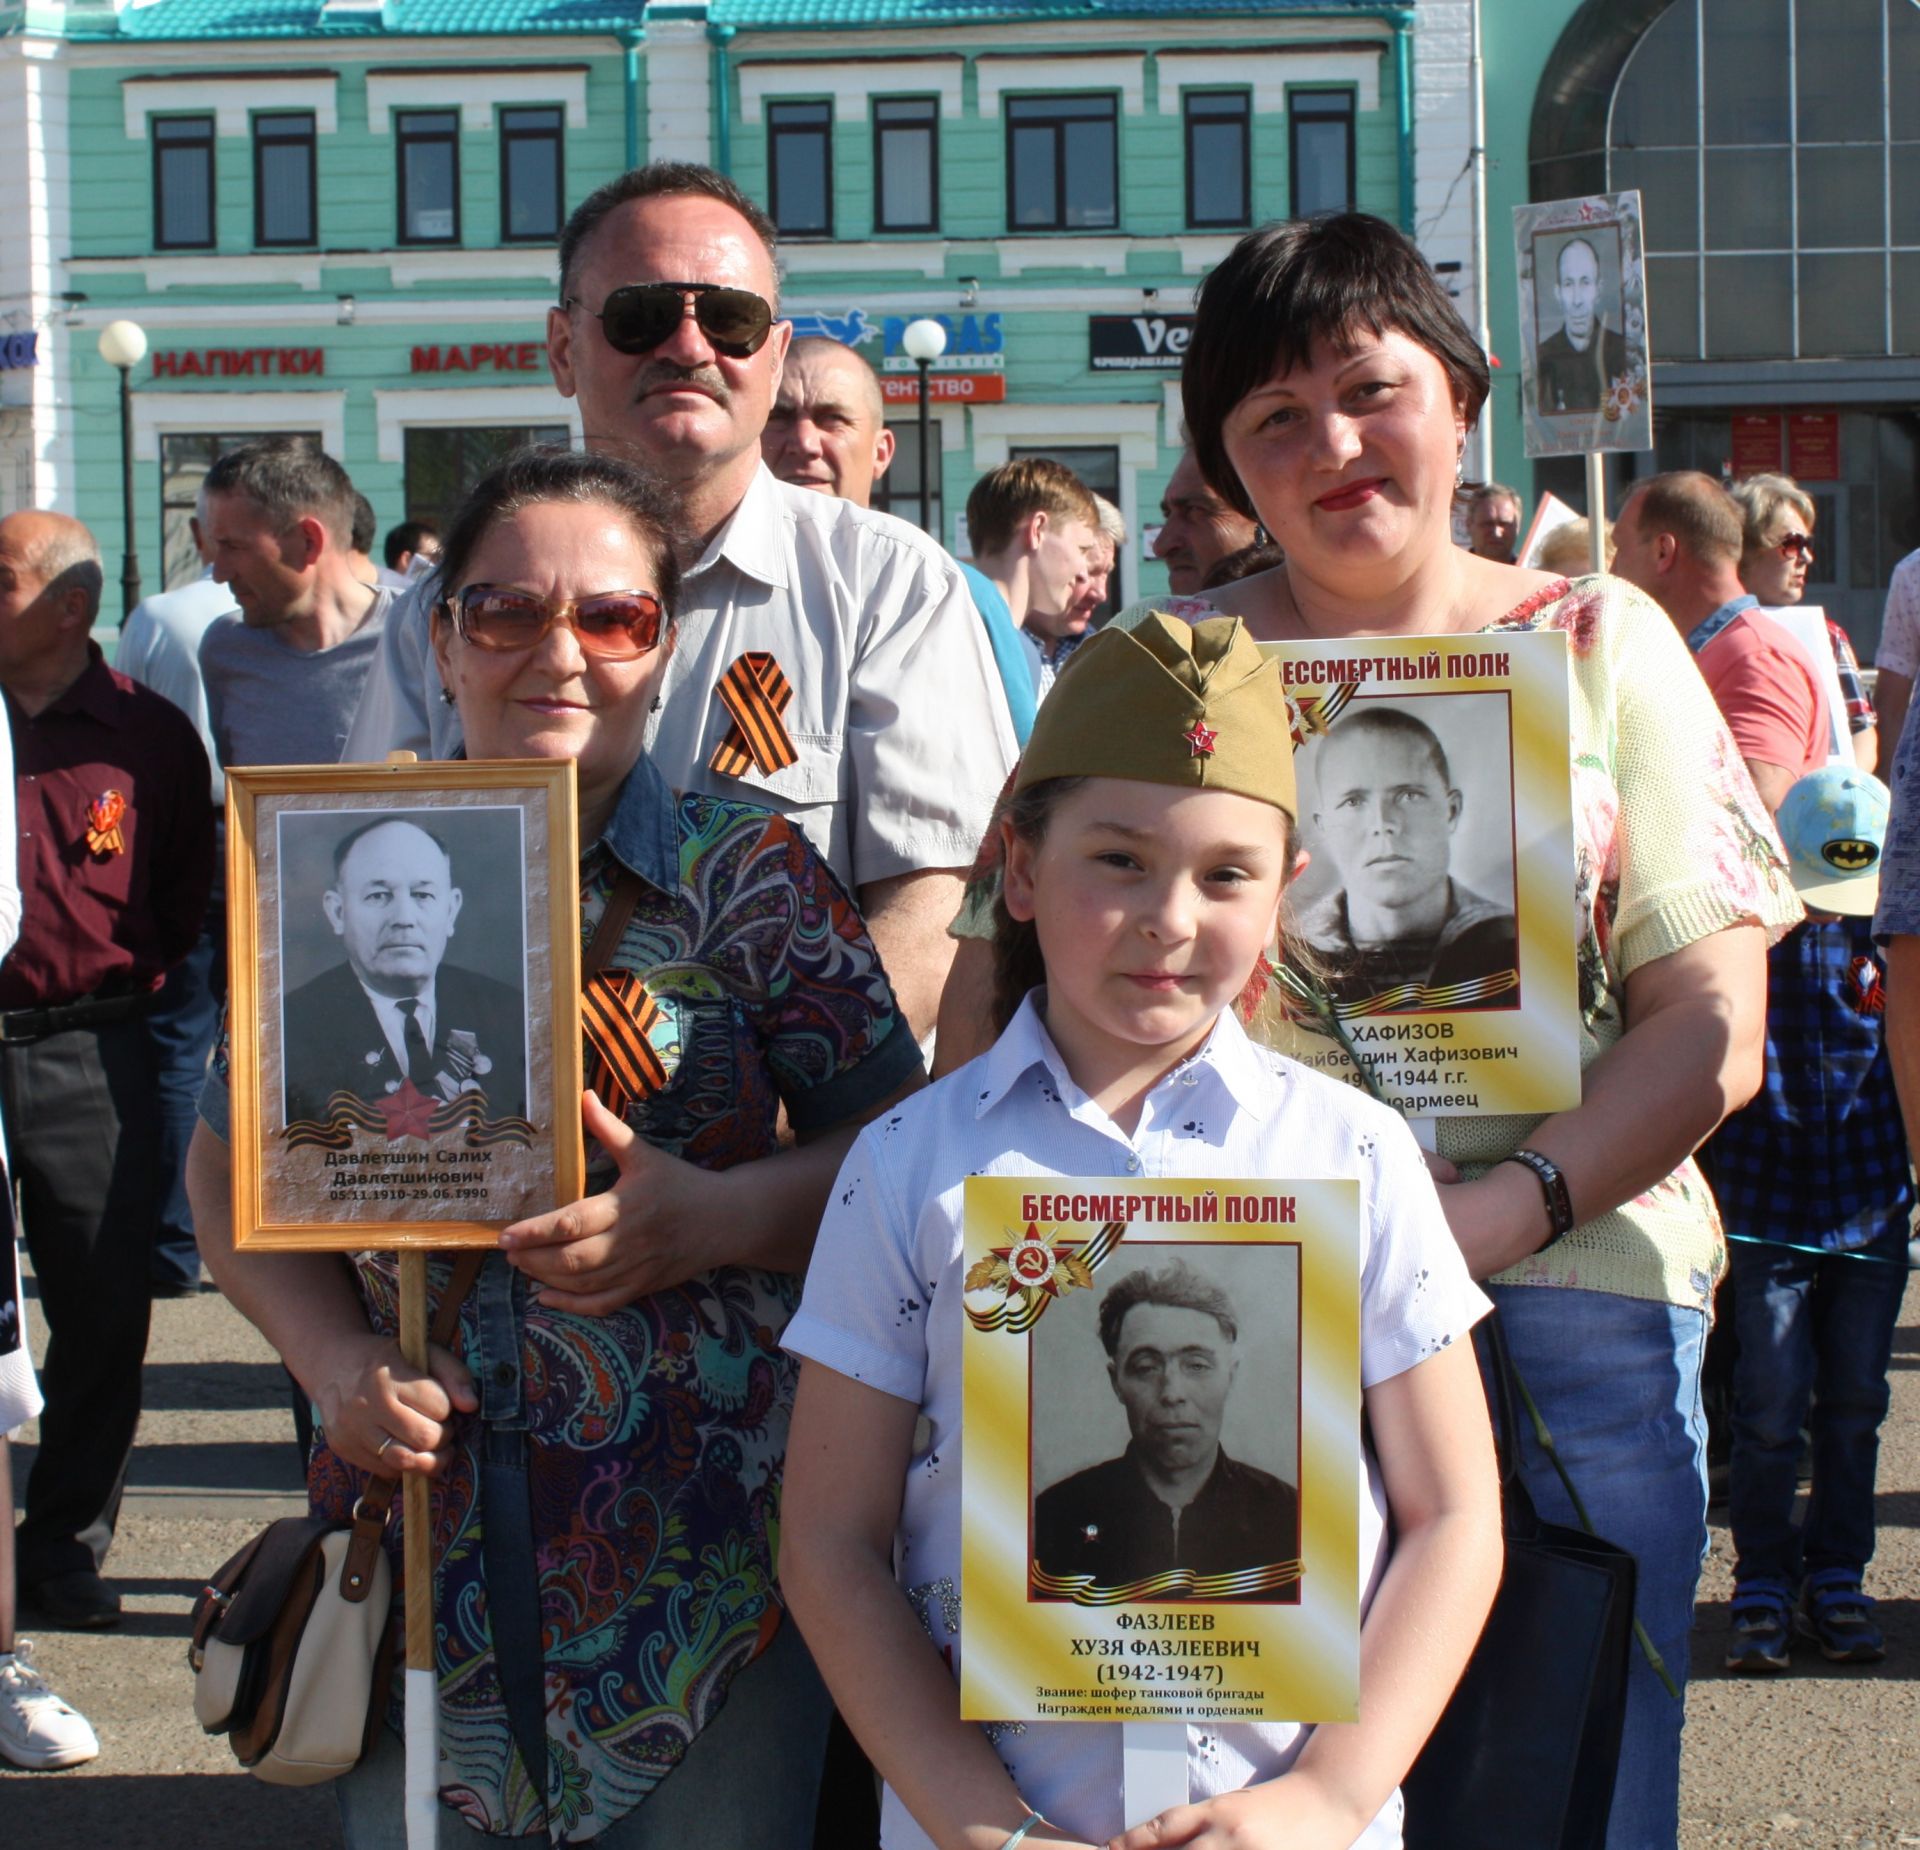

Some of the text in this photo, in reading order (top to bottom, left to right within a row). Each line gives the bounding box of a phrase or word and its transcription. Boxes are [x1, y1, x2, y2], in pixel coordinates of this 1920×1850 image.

[1132, 318, 1194, 354] Ve
[153, 348, 324, 378] НАПИТКИ
[1280, 651, 1511, 685] ЕССМЕРТНЫЙ ПОЛК
[1352, 1023, 1454, 1042] ХАФИЗОВ
[1288, 1046, 1518, 1067] Хайбедин Хафизович
[1342, 1070, 1468, 1088] 191-1944 г.г.
[325, 1149, 492, 1167] Давлетшин Салих
[333, 1171, 484, 1187] Давлетшинович
[330, 1188, 488, 1201] 05.11.1910-29.06.1990
[1022, 1190, 1297, 1223] БЕССМЕРТНЫЙ ПОЛК
[1116, 1613, 1215, 1631] ФАЗЛЕЕВ
[1071, 1639, 1260, 1657] ХУЗЯ ФАЗЛЕЕВИЧ
[1097, 1664, 1224, 1685] (1942-1947)
[1036, 1686, 1265, 1701] Звание: шофер танковой бригады
[1037, 1703, 1264, 1717] Награжден медалями и орденами
